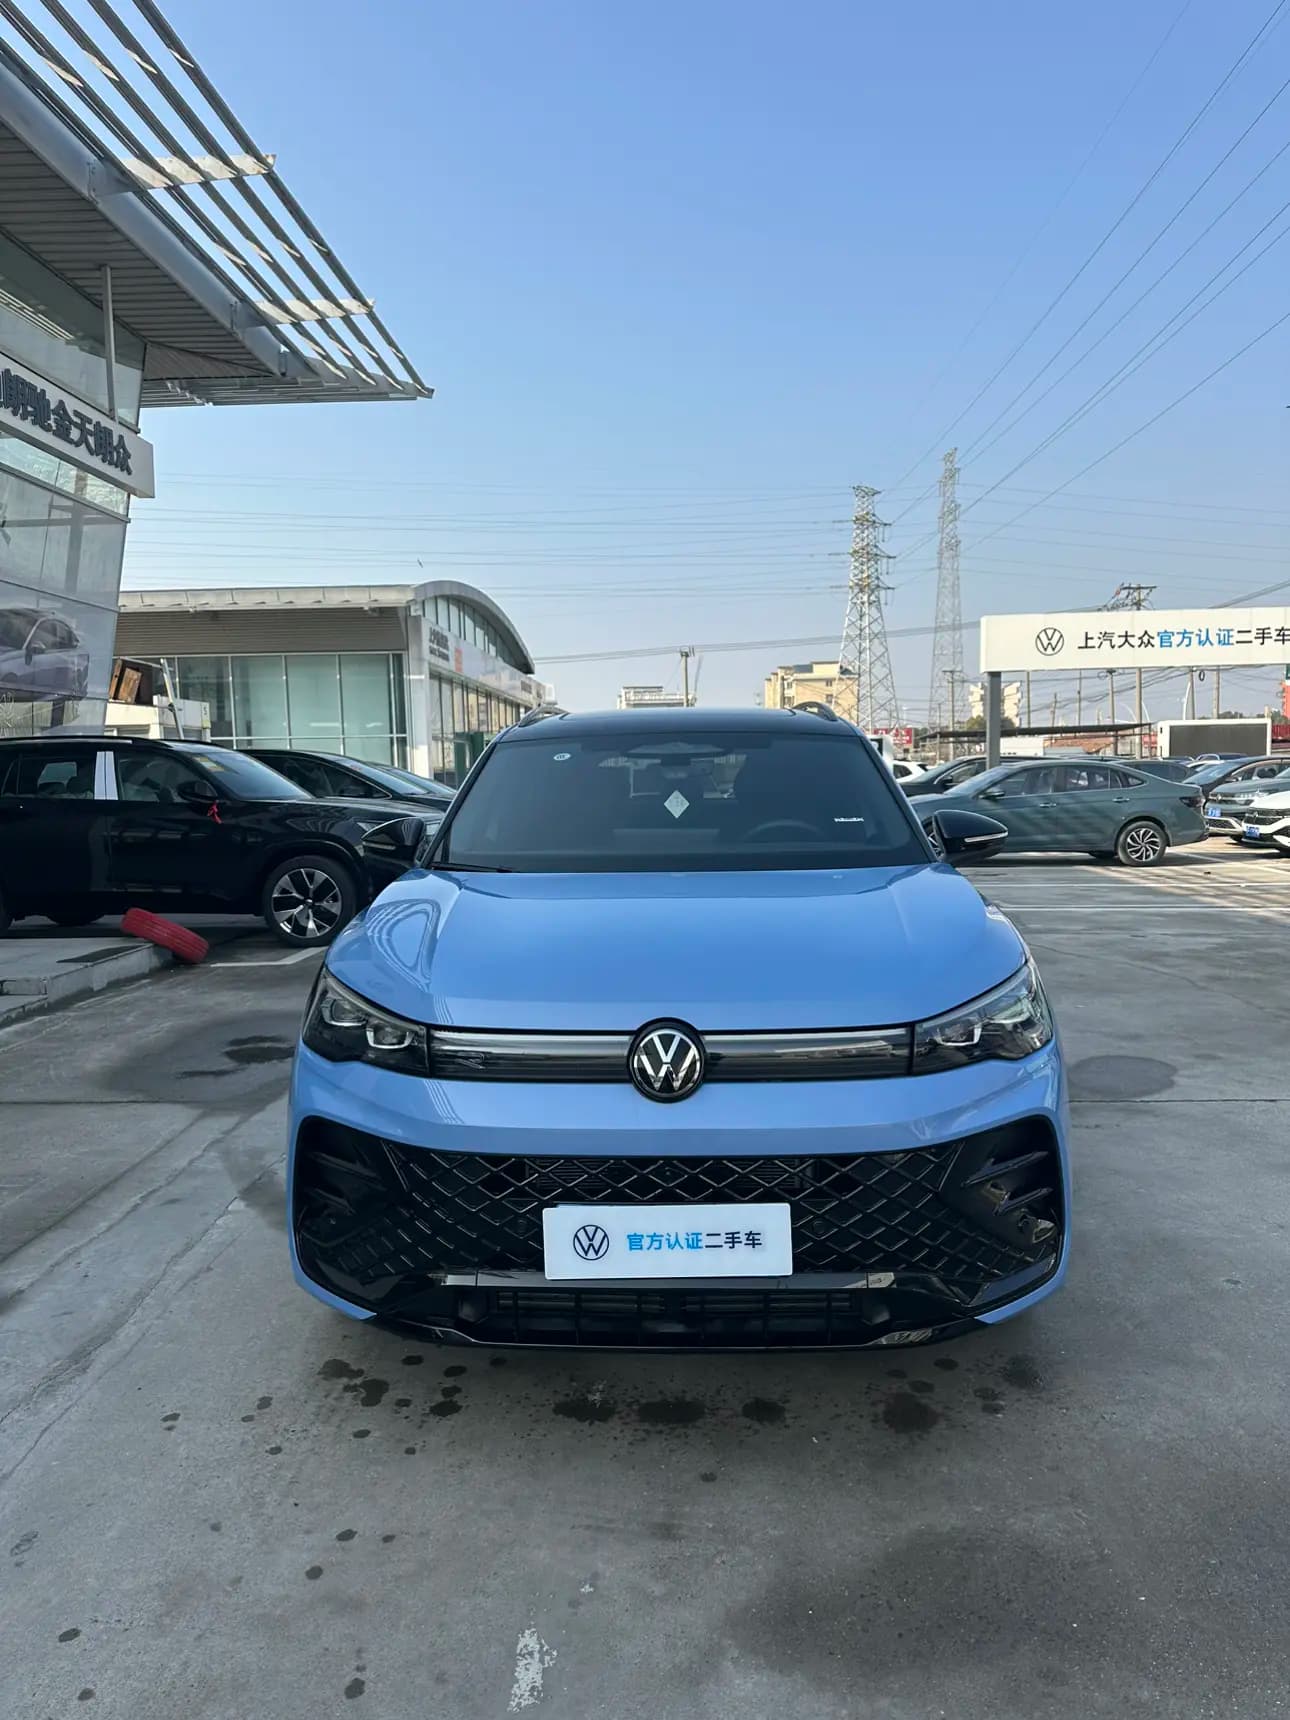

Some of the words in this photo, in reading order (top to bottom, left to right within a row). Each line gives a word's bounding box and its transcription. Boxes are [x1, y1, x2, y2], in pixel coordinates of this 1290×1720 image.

[1077, 626, 1290, 650] 上汽大众官方认证二手车
[626, 1230, 763, 1251] 官方认证二手车
